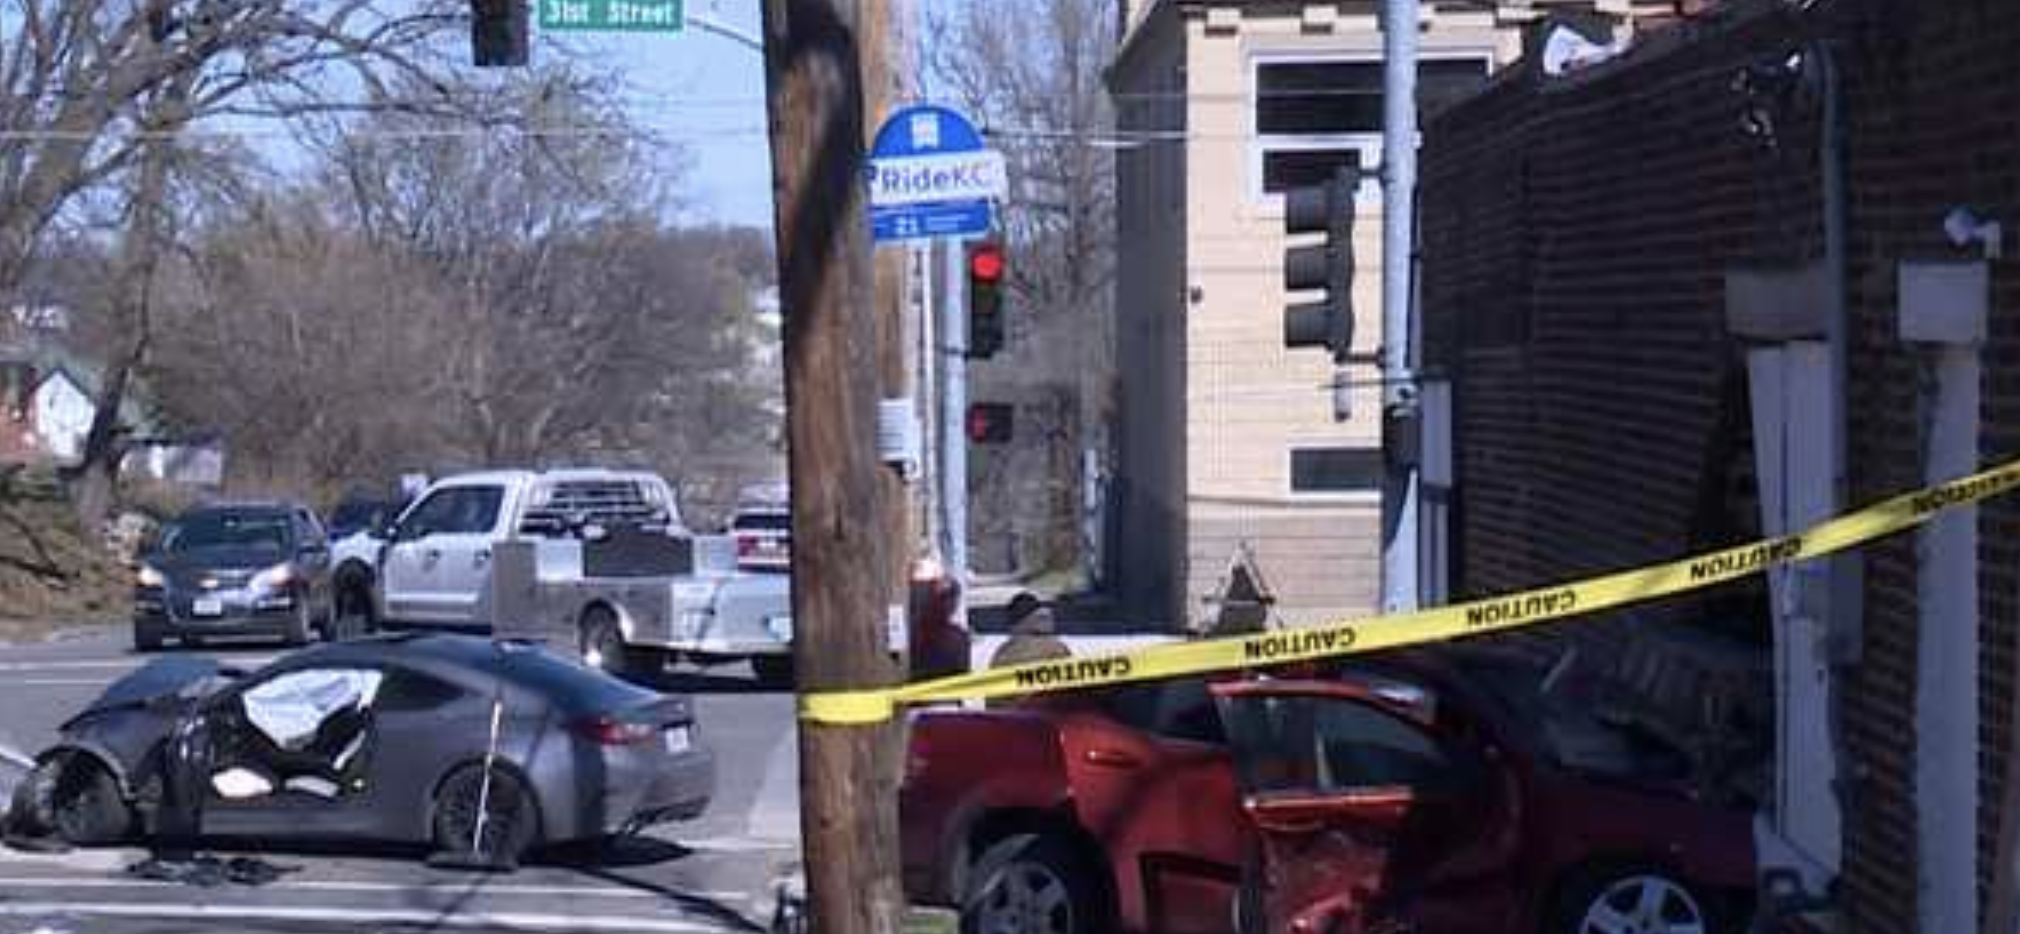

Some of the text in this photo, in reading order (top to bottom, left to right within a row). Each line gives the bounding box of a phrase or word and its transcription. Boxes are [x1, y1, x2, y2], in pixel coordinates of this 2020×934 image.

[606, 0, 673, 24] Street
[881, 164, 993, 193] RideKC
[1467, 589, 1576, 626] CAUTION
[1245, 628, 1357, 660] CAUTION
[1014, 655, 1131, 688] CAUTION
